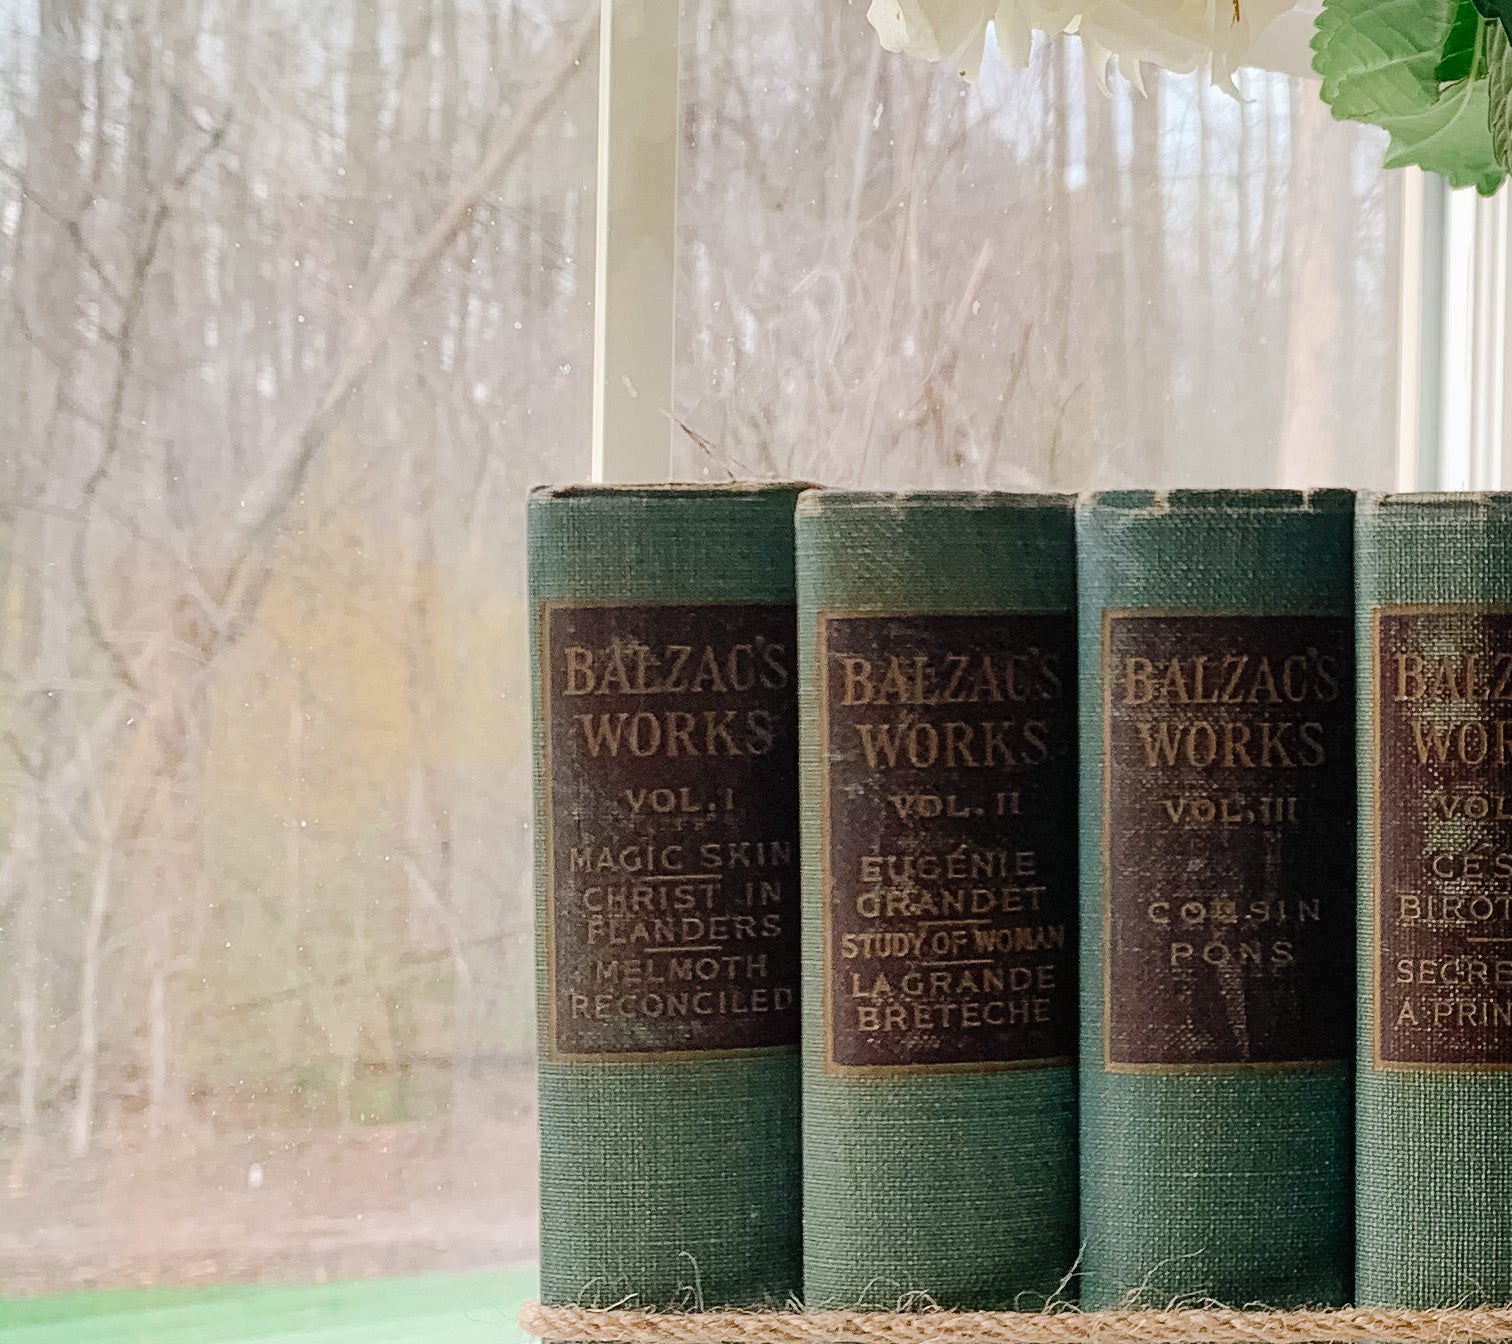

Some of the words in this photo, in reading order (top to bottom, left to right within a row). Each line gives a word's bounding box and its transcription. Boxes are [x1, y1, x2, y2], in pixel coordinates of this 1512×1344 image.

[563, 636, 789, 697] BALZAC'S
[839, 649, 1064, 707] BALZAC'S
[1123, 647, 1340, 705] BALZAC'S
[575, 710, 774, 758] WORKS
[855, 719, 1051, 769] WORKS
[1135, 719, 1328, 768] WORKS
[569, 844, 686, 874] MAGIC
[700, 840, 794, 869] SKIN
[583, 882, 721, 914] CHRIST
[744, 879, 782, 905] IN
[855, 885, 1046, 920] GRANDET
[1146, 899, 1322, 926] COUSIN
[587, 914, 783, 947] FLANDERS
[841, 930, 925, 959] STUDY
[931, 929, 968, 955] OF
[974, 924, 1066, 953] WOMAN
[595, 954, 768, 984] MELMOTH
[1169, 940, 1296, 968] PONS
[851, 971, 889, 1000] LA
[898, 964, 1056, 997] GRANDE
[569, 986, 794, 1020] RECONCILED
[1397, 1001, 1420, 1027] A
